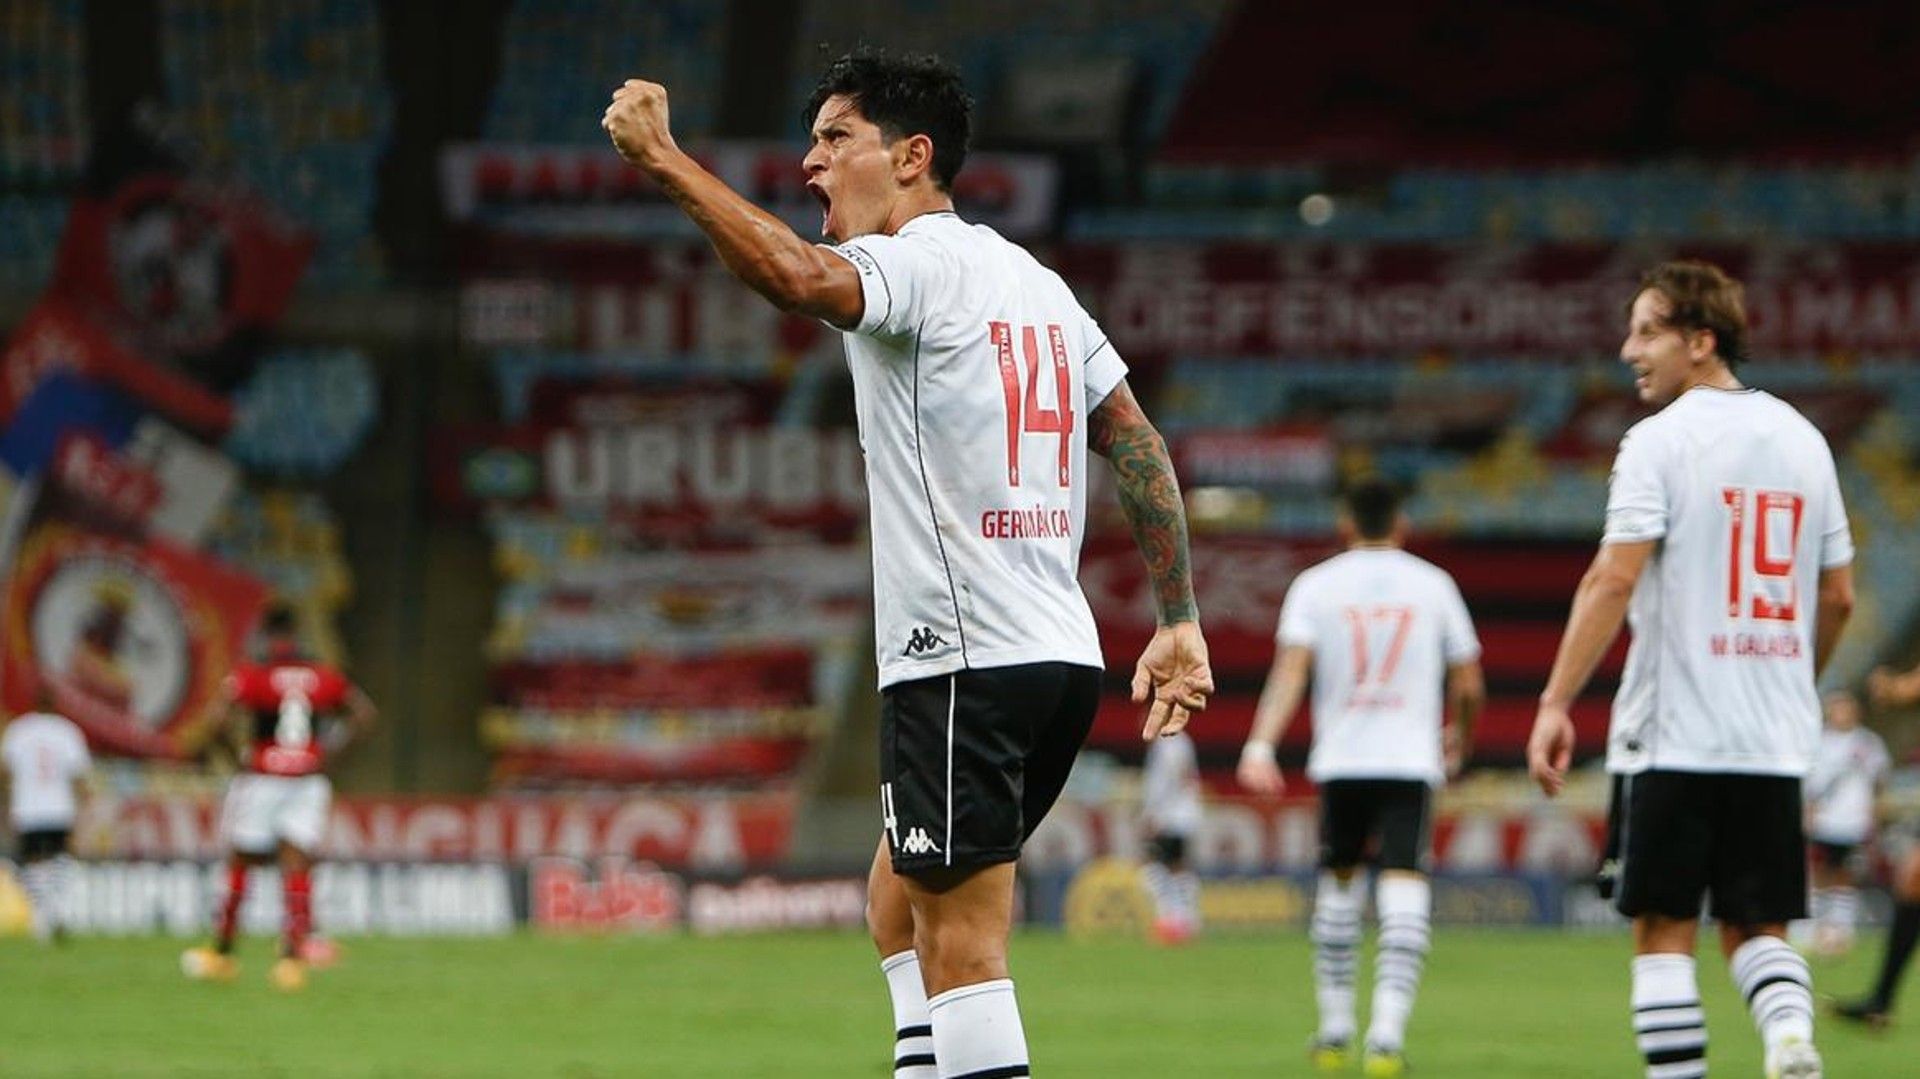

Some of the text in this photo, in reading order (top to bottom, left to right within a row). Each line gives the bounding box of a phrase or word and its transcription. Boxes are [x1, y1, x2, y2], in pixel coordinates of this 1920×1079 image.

[988, 321, 1074, 488] 14
[1723, 486, 1804, 622] 19
[1344, 604, 1412, 686] 17
